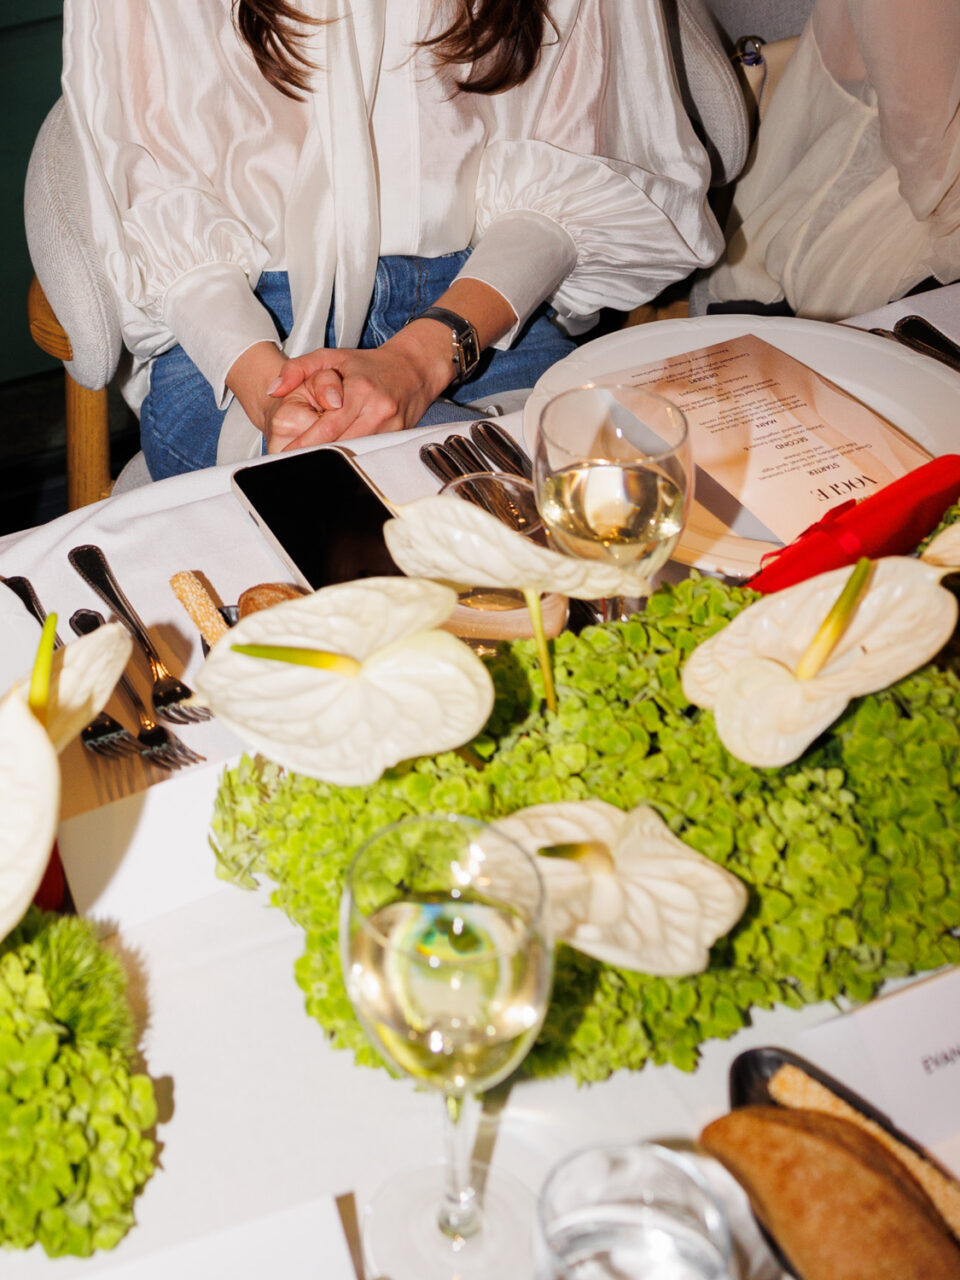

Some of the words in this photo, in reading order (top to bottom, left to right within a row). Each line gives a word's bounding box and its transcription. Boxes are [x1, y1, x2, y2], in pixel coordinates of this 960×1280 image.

[686, 372, 720, 384] DESSERT
[752, 418, 779, 429] MAIN
[772, 435, 810, 450] SECOND
[805, 461, 841, 476] STARTER
[807, 472, 879, 502] VOGUE
